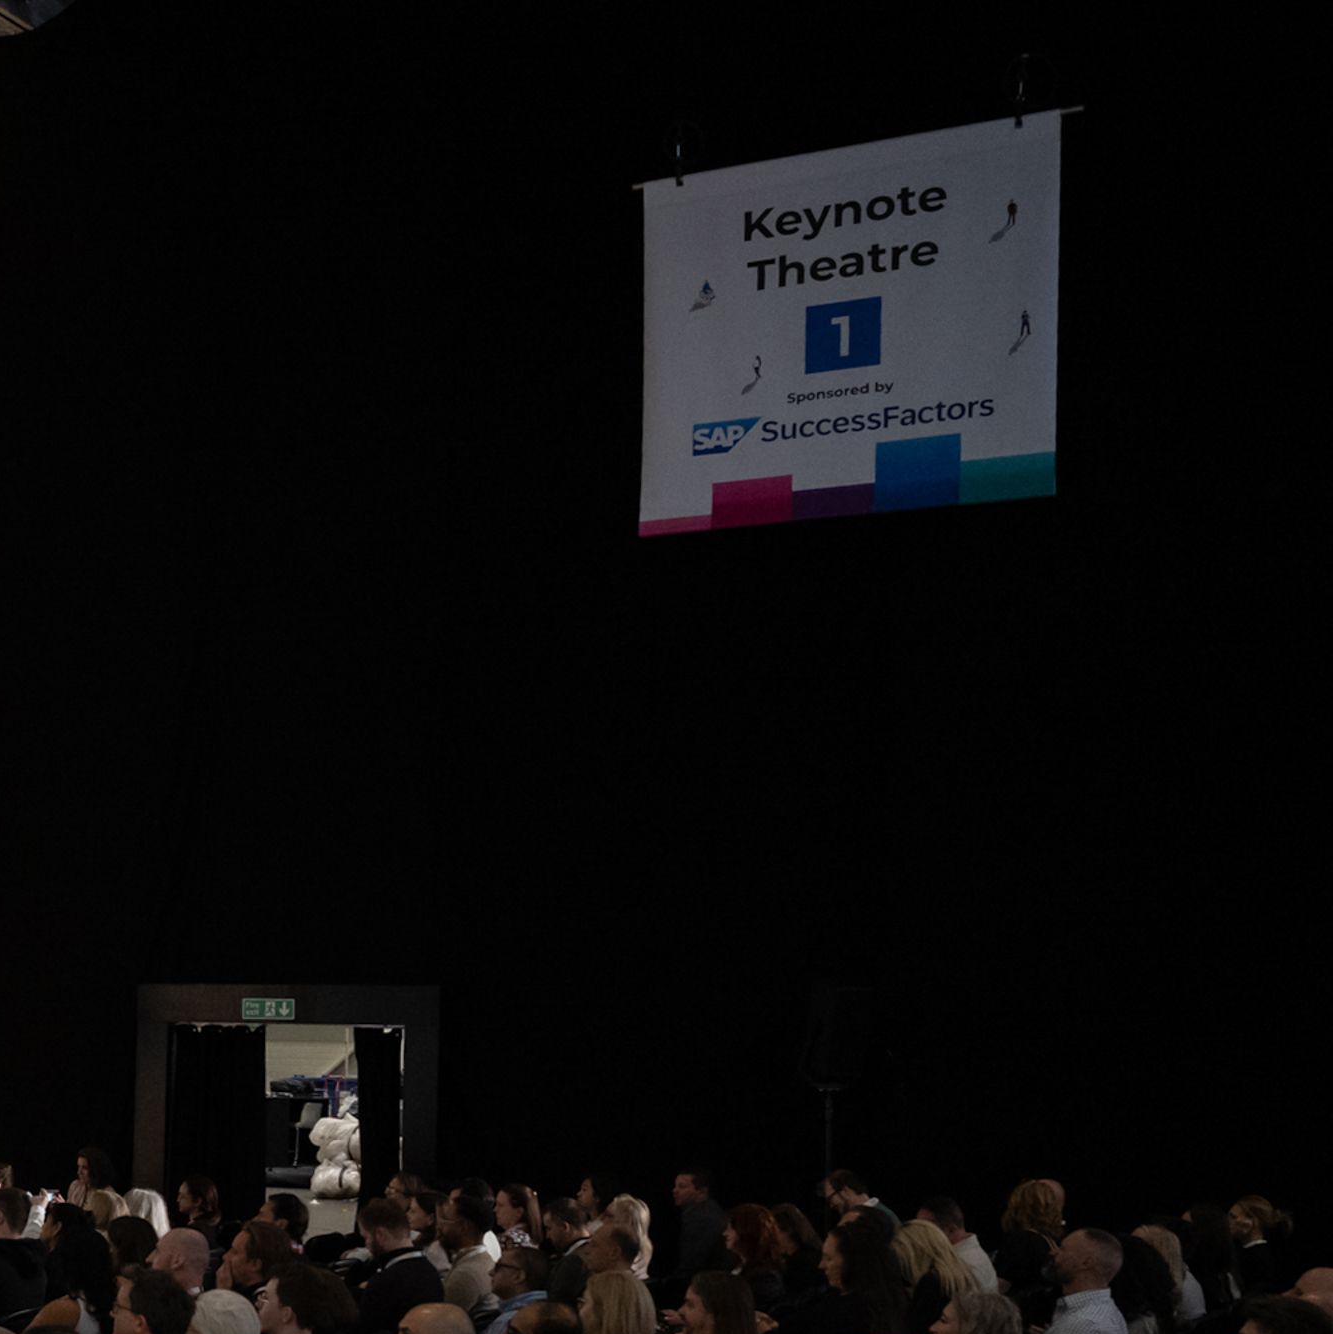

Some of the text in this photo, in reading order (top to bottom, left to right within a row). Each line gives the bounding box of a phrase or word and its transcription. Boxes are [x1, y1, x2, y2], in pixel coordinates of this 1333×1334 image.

[744, 185, 947, 242] Keynote
[748, 240, 938, 291] Theatre
[831, 316, 850, 357] 1
[787, 380, 893, 405] Sponsored by
[694, 399, 994, 451] SAP SuccessFactors
